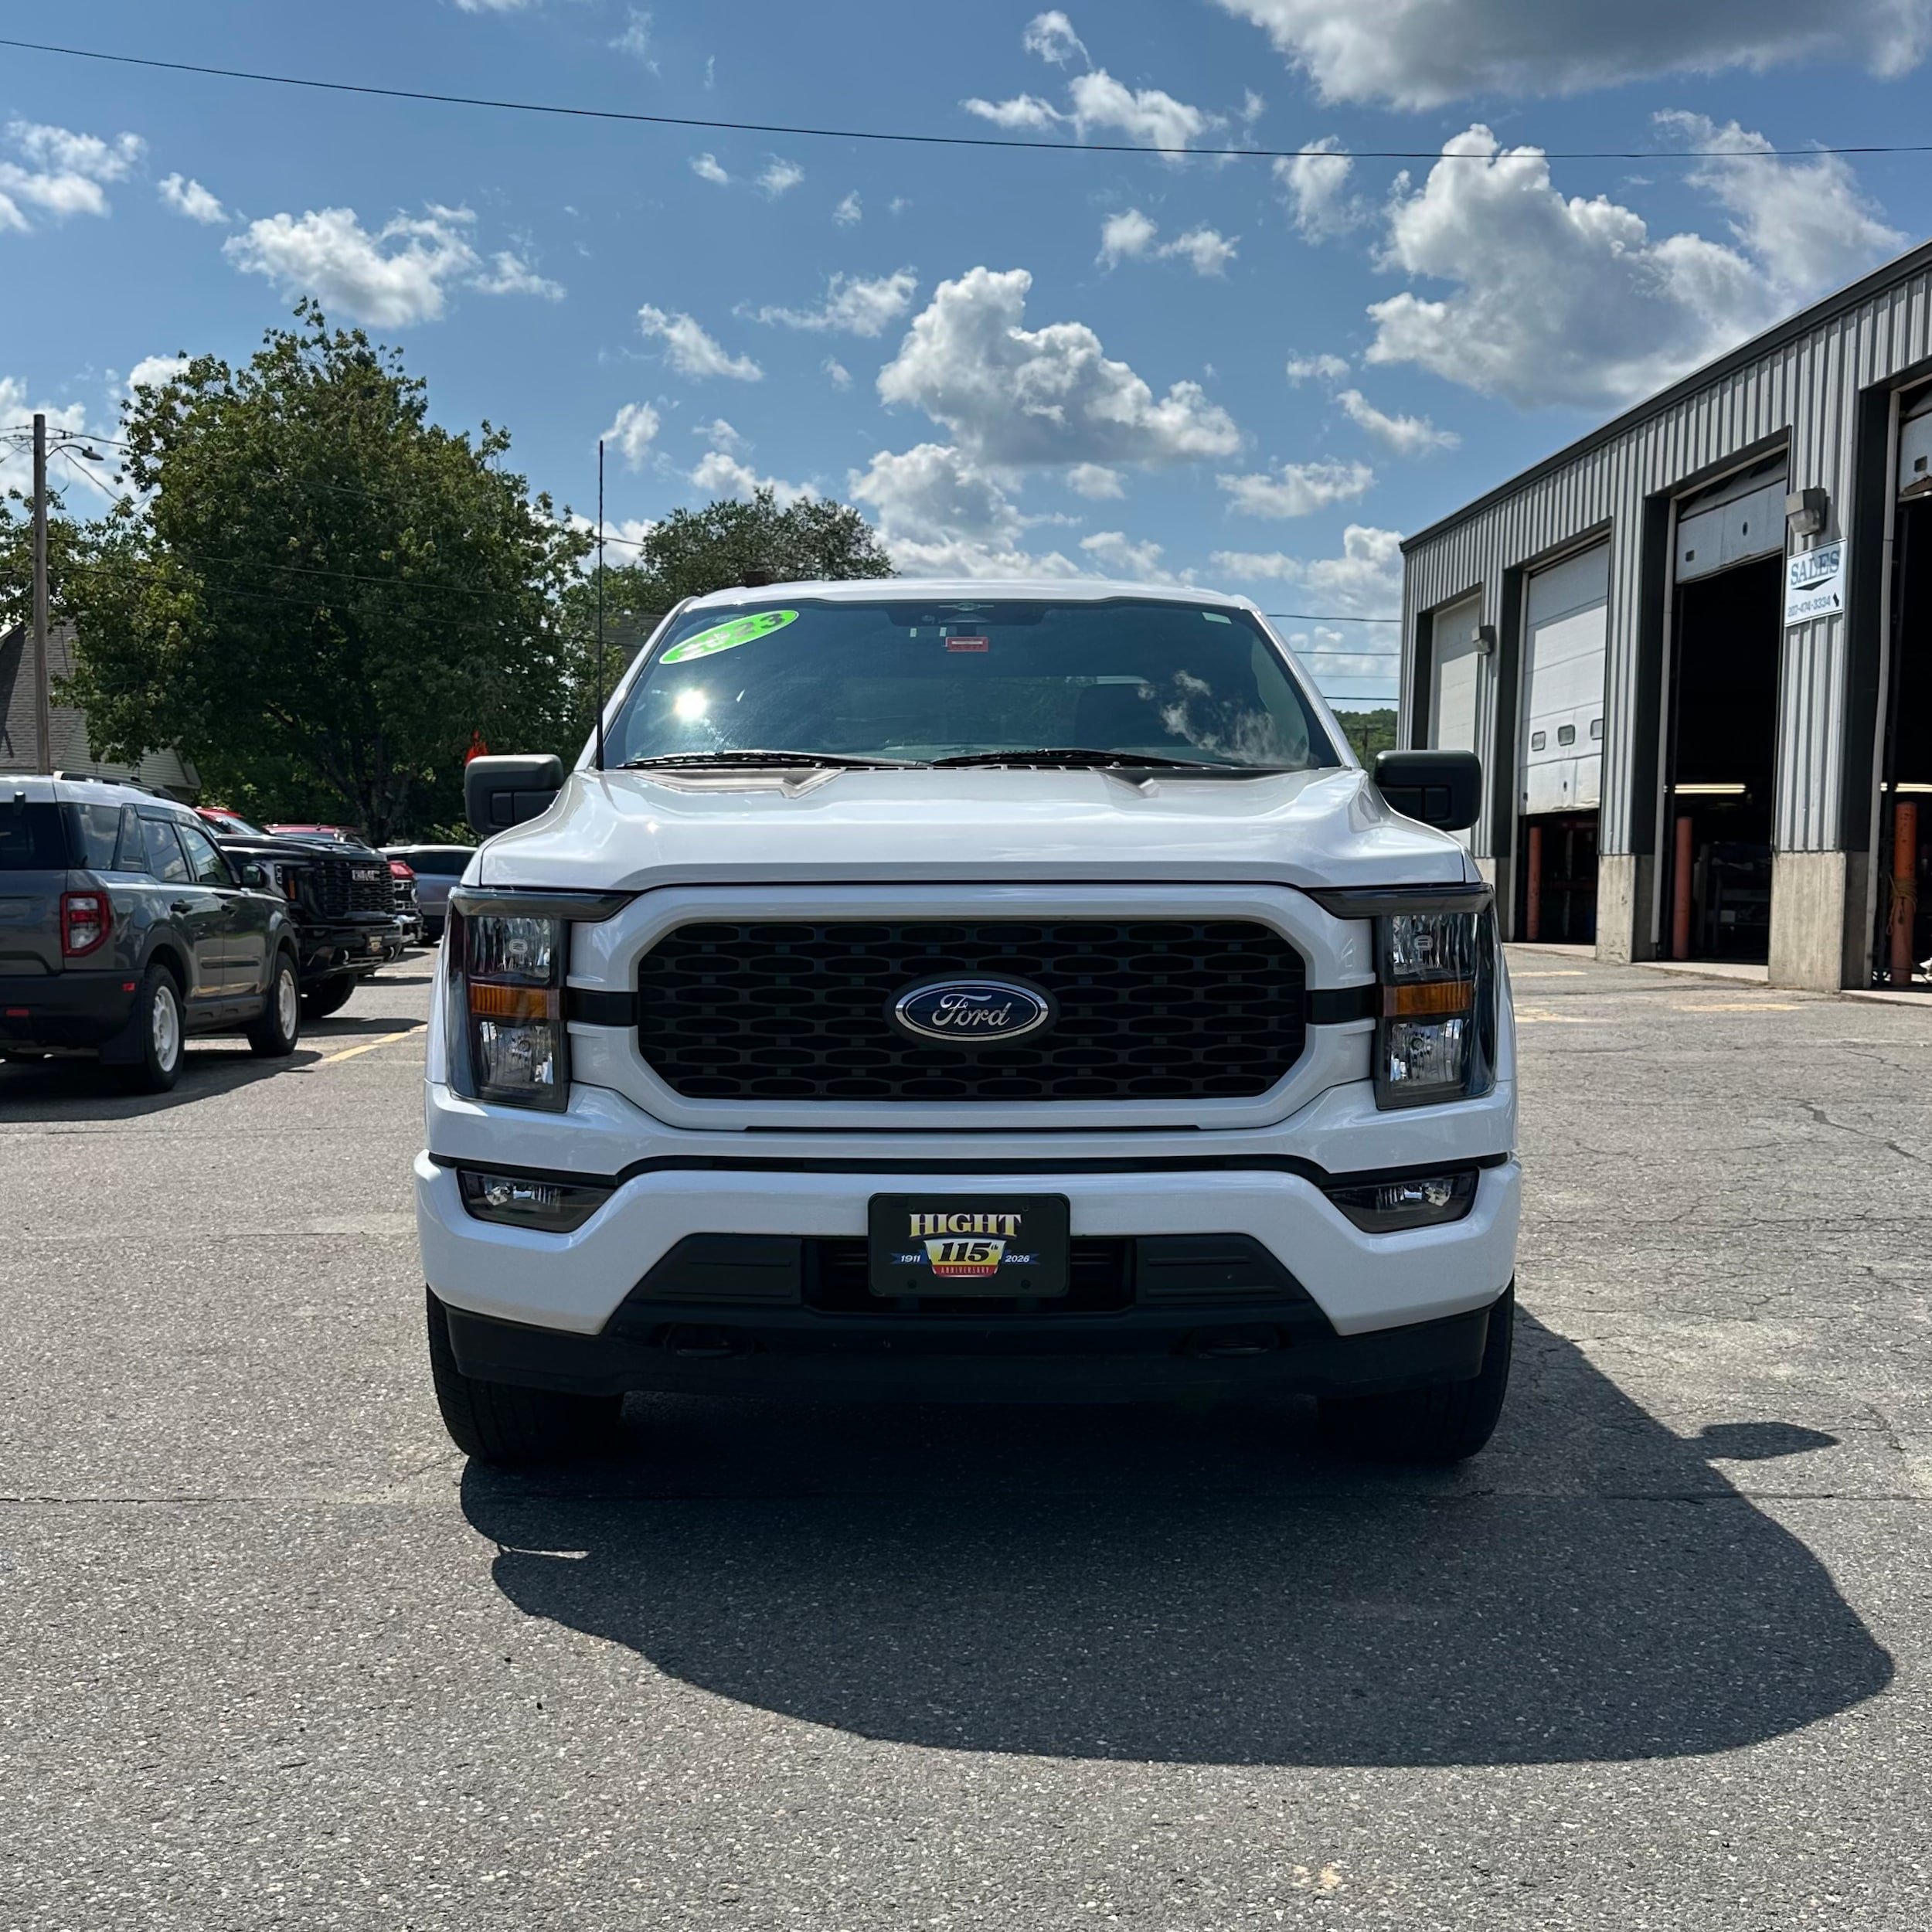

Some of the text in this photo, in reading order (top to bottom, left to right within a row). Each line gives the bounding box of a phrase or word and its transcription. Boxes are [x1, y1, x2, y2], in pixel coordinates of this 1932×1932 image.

[1791, 550, 1839, 585] SALES
[352, 869, 380, 881] GMC
[932, 993, 1012, 1026] Ford
[909, 1213, 1022, 1237] HIGHT
[940, 1266, 990, 1274] ANNIVERSARY
